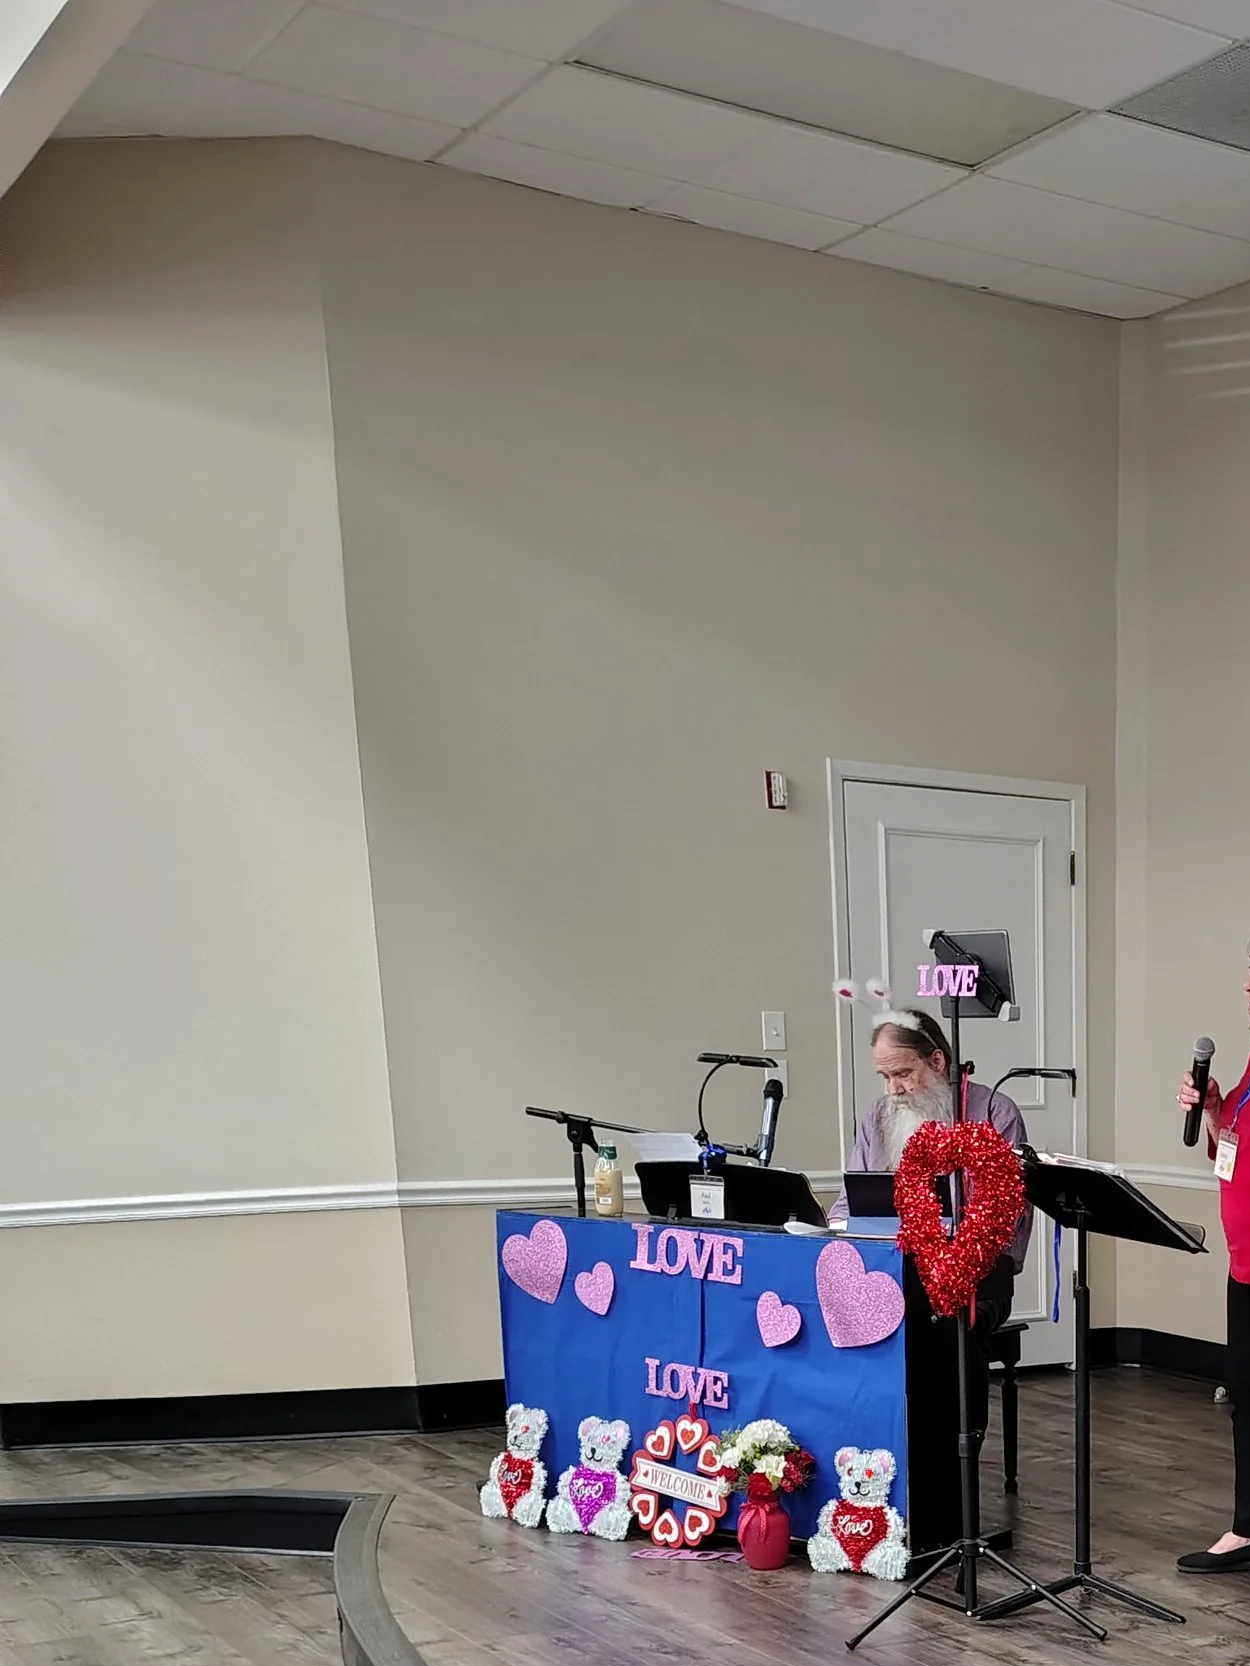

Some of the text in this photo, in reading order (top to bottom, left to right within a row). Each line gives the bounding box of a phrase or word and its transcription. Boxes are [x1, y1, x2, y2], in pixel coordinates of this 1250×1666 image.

[916, 964, 979, 997] LOVE
[629, 1222, 744, 1286] LOVE
[644, 1356, 729, 1410] LOVE
[571, 1477, 604, 1499] Love
[651, 1468, 706, 1501] WELCOME
[836, 1514, 873, 1536] Love
